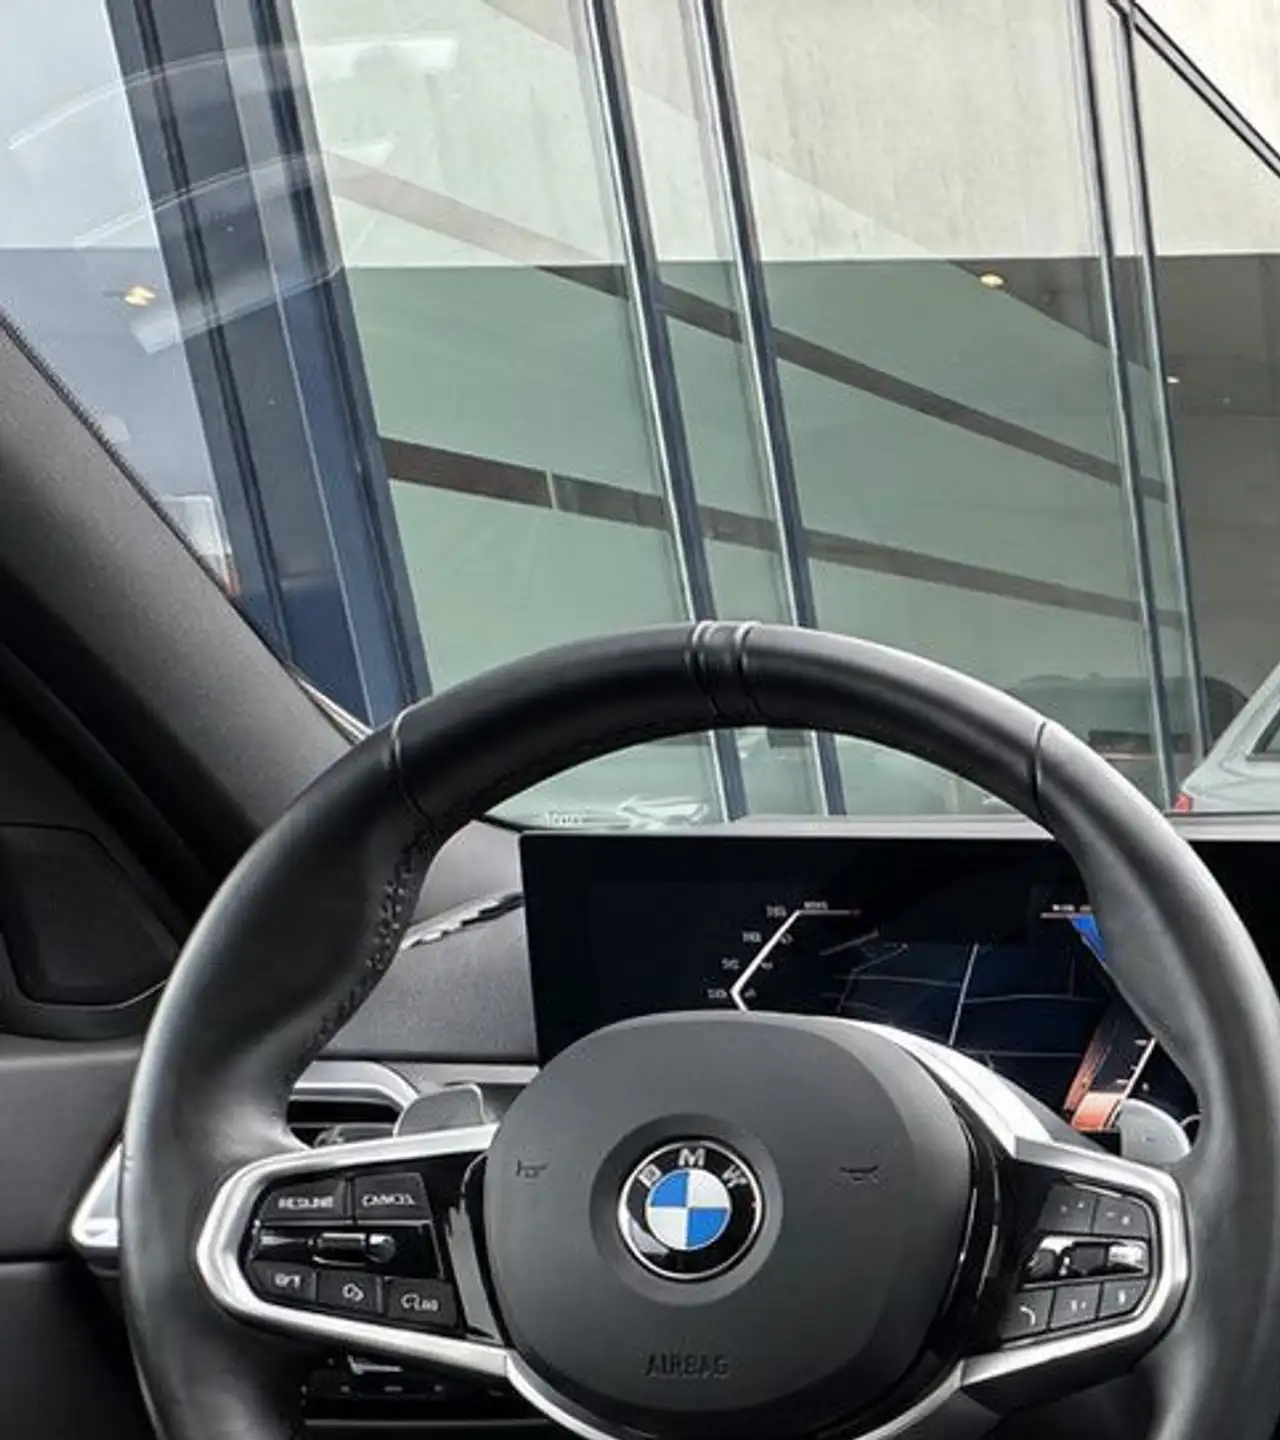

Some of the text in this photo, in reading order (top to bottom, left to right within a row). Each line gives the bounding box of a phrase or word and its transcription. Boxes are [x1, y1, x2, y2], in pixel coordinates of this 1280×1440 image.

[637, 1147, 748, 1189] BMW
[277, 1195, 334, 1210] RESUME
[361, 1192, 416, 1208] CANCEL
[645, 1353, 731, 1379] AIRBAG
